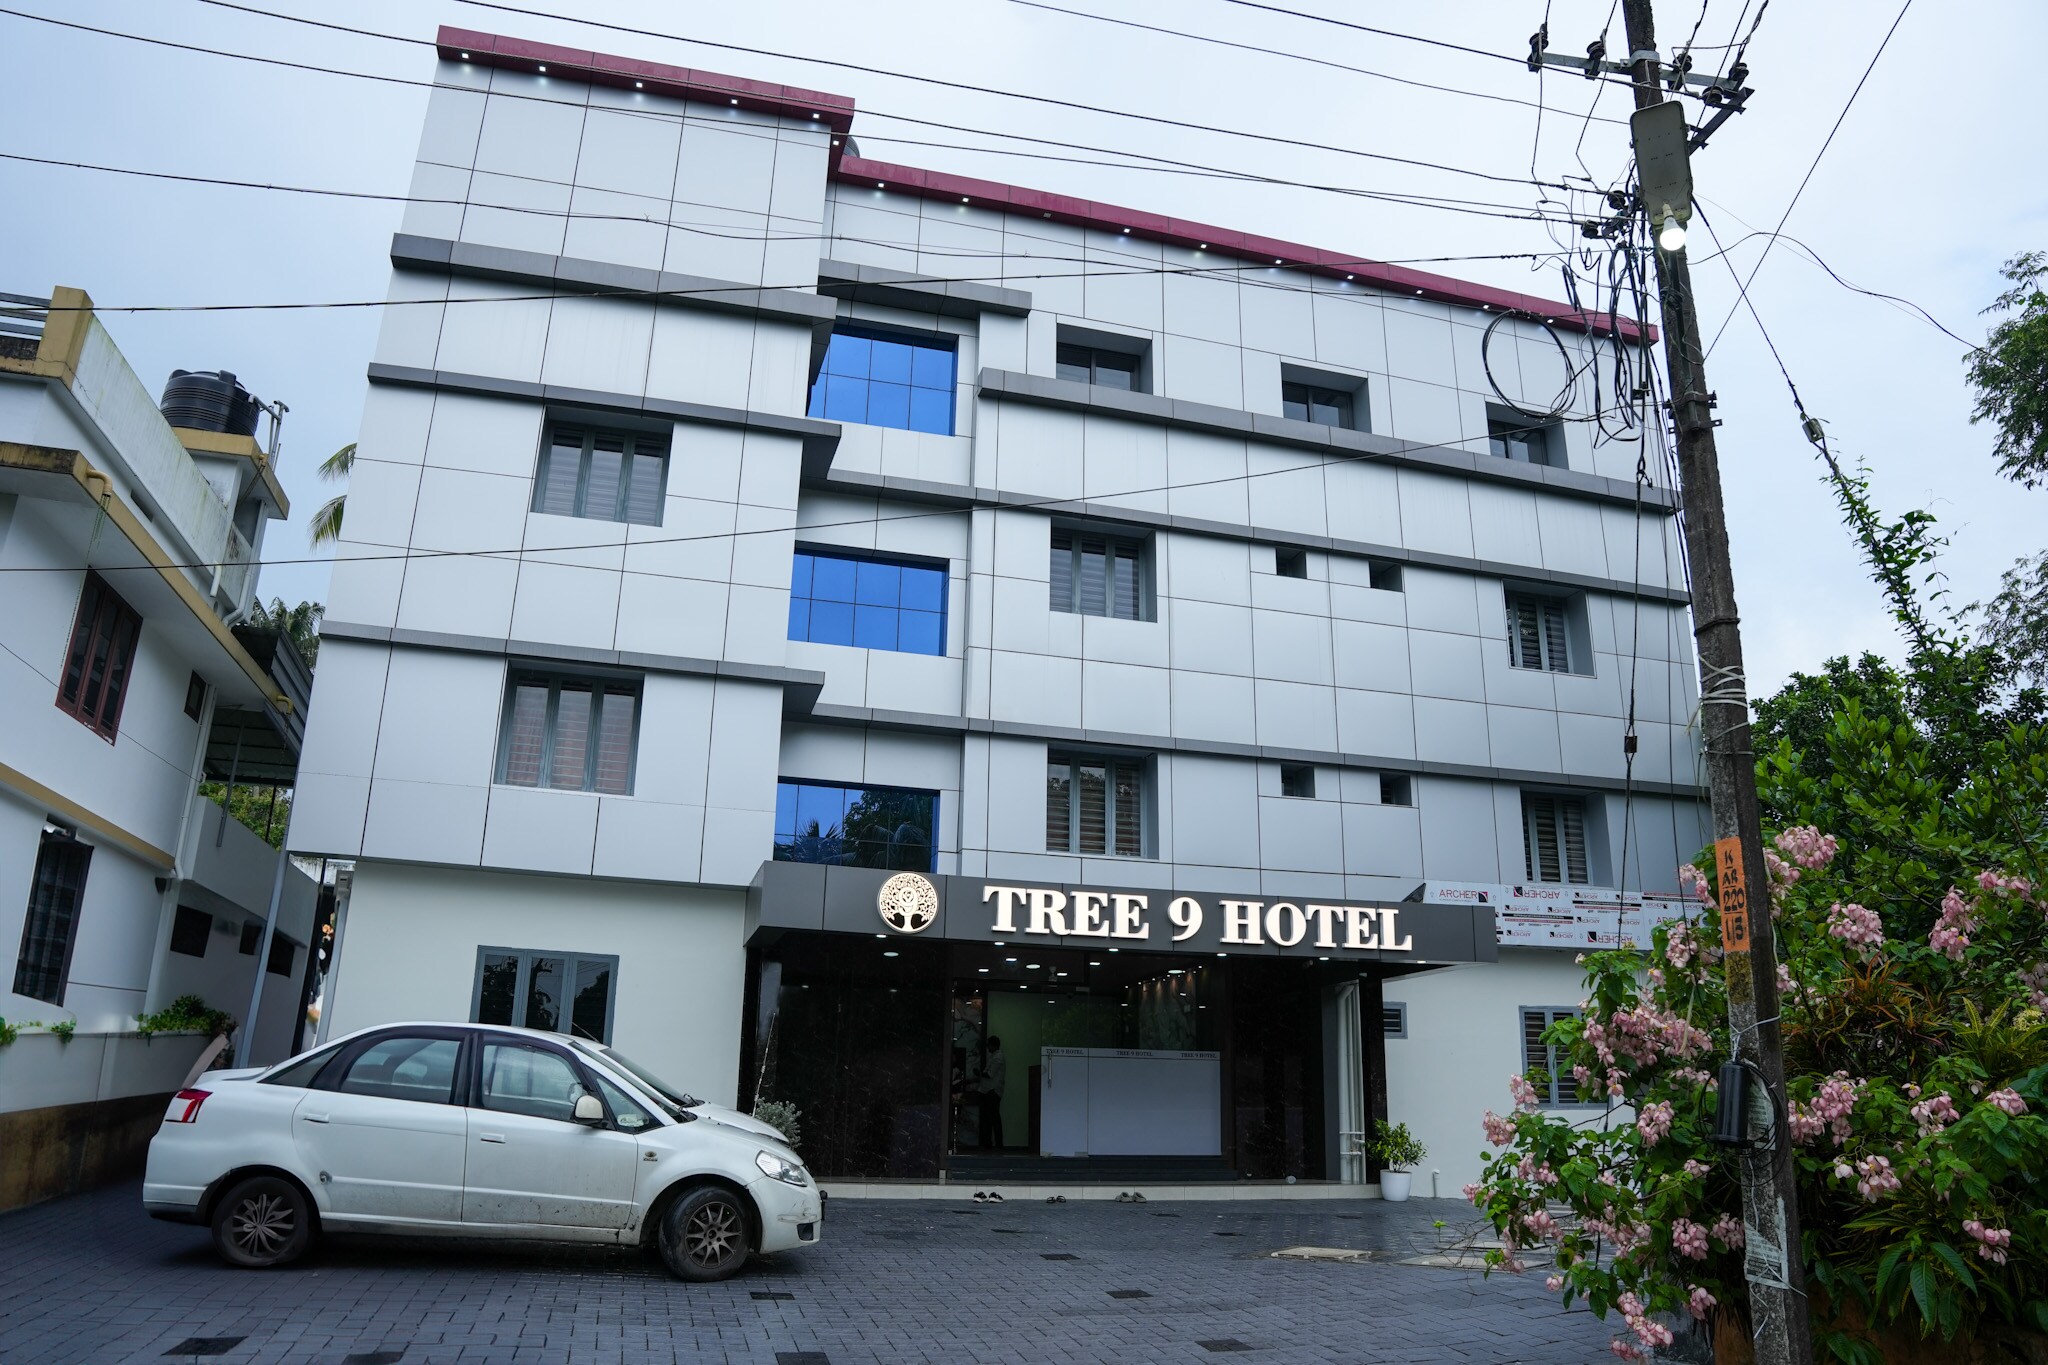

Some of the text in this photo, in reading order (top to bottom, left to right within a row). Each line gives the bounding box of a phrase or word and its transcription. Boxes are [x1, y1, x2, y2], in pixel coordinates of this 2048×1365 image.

[1724, 849, 1733, 866] K
[1722, 868, 1738, 885] AR
[1439, 889, 1478, 899] ARCHER
[1523, 889, 1560, 899] ARCHER
[1723, 887, 1745, 912] 220
[982, 884, 1414, 952] TREE 9 HOTEL
[1597, 934, 1633, 943] ARCHER
